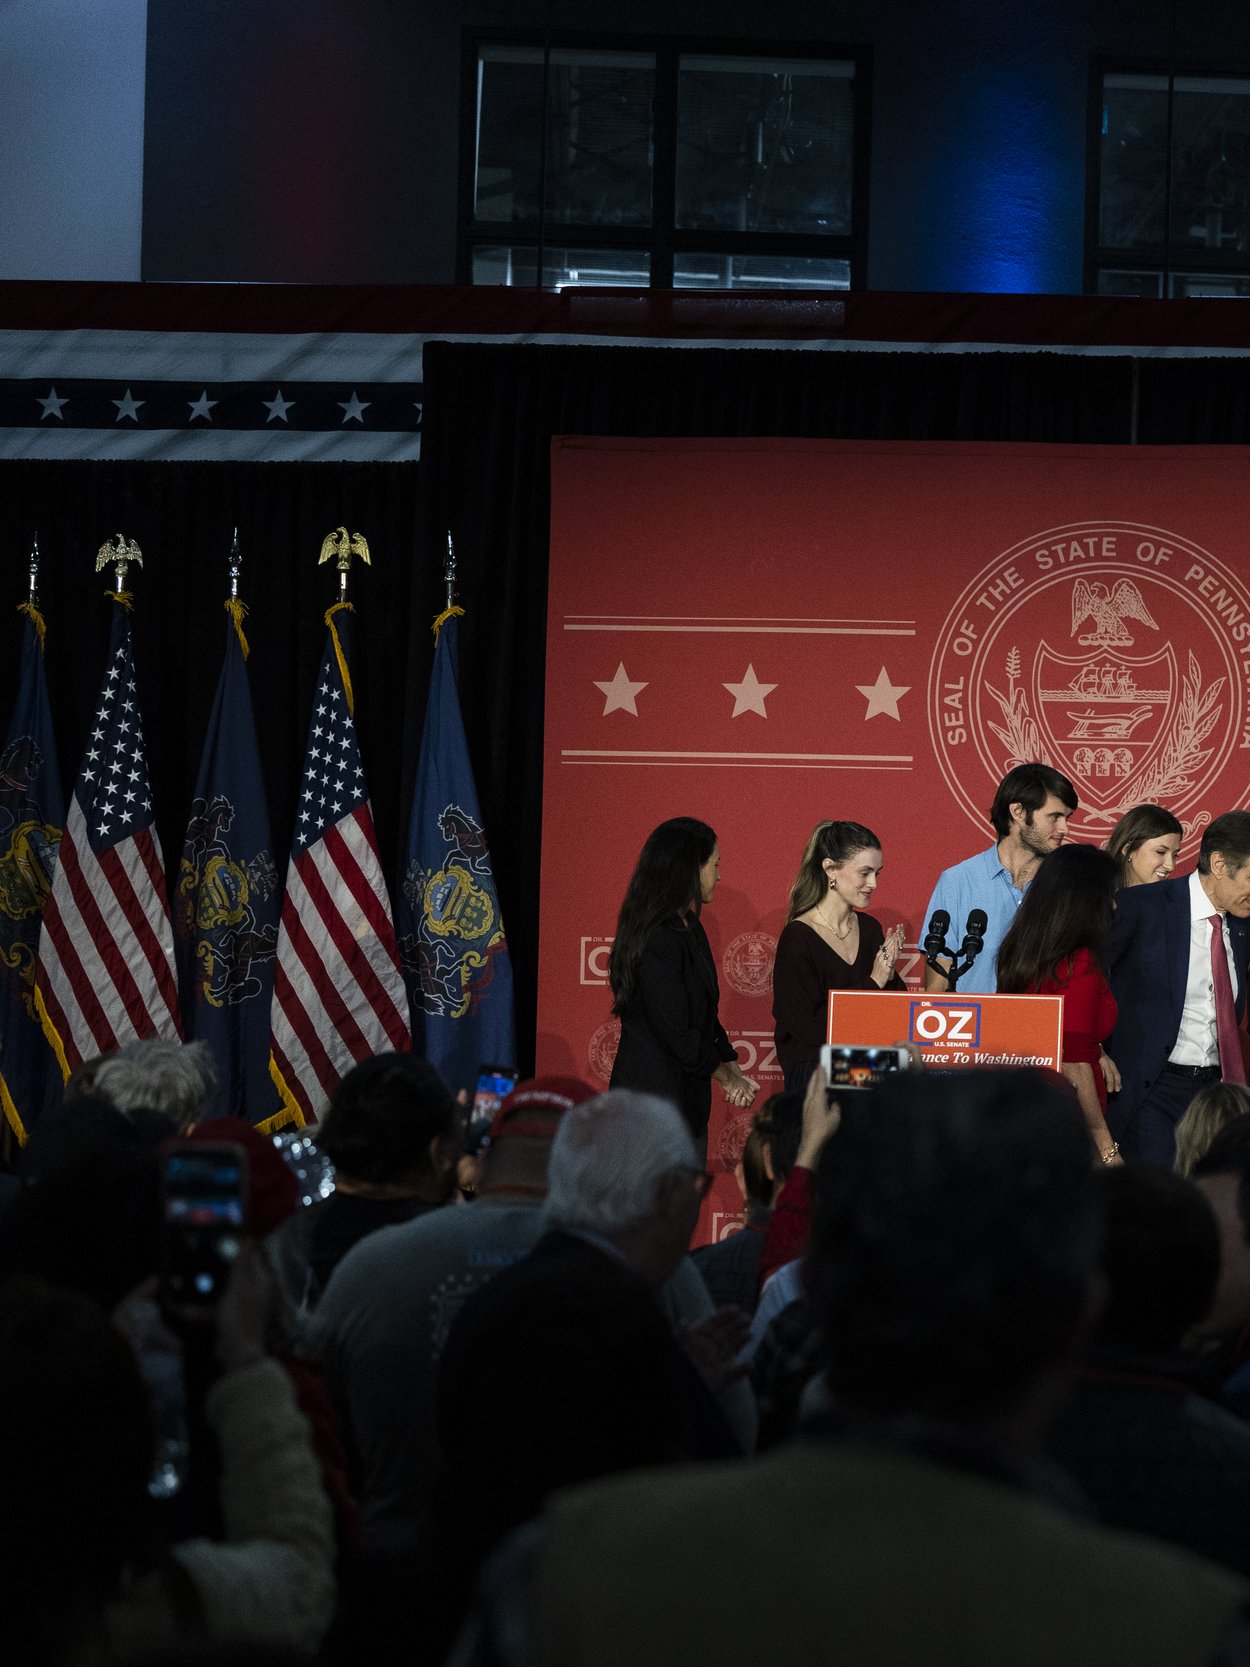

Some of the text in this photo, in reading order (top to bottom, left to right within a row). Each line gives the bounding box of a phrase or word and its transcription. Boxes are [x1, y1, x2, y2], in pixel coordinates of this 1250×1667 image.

[1035, 536, 1118, 570] STATE
[1136, 542, 1173, 567] OF
[975, 566, 1024, 612] THE
[952, 619, 978, 656] OF
[943, 675, 967, 746] SEAL
[897, 953, 921, 984] Z
[916, 1009, 973, 1040] OZ
[731, 1039, 783, 1072] OZ
[953, 1052, 969, 1064] To
[974, 1053, 1053, 1067] Washington
